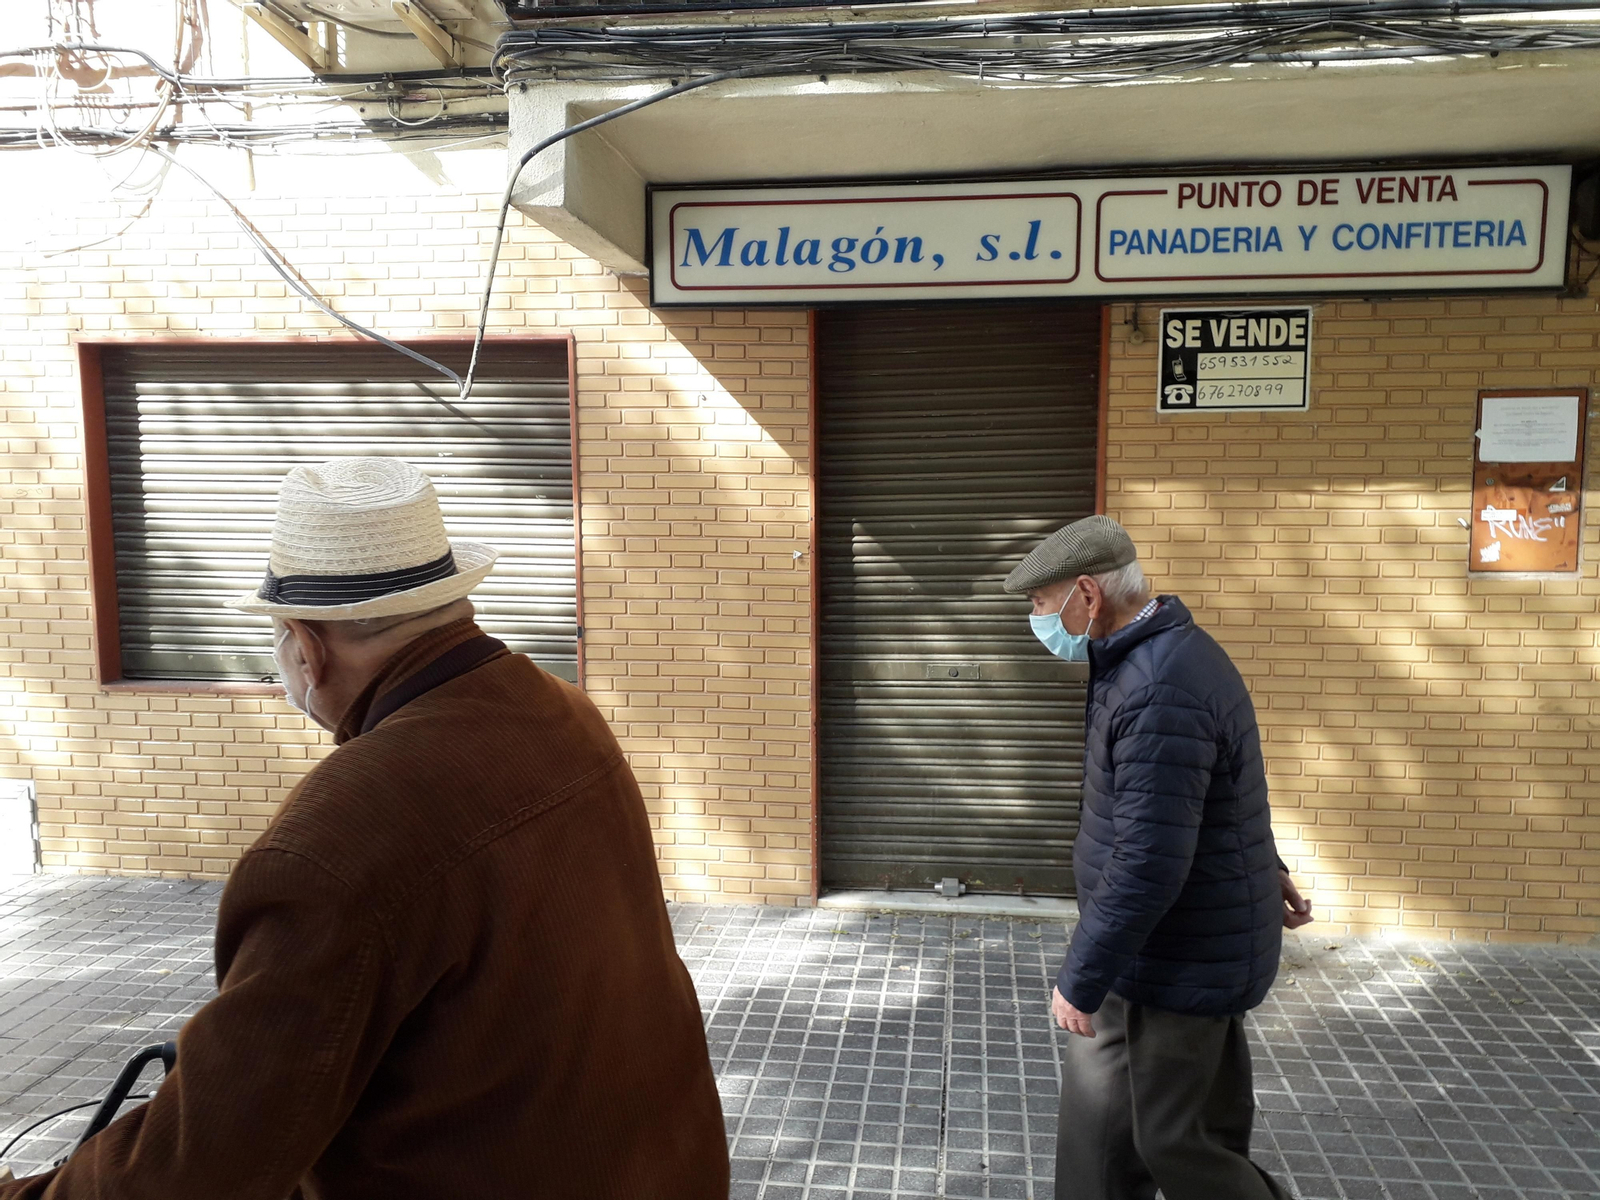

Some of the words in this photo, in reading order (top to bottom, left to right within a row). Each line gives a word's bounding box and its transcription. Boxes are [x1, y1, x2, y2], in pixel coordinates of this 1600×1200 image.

[1177, 179, 1282, 209] PUNTO
[1297, 178, 1340, 206] DE
[1356, 175, 1458, 204] VENTA
[679, 226, 945, 273] Malagón,
[975, 220, 1063, 262] s.l.
[1109, 225, 1283, 256] PANADERIA
[1298, 224, 1318, 251] Y
[1332, 219, 1527, 252] CONFITERIA
[1166, 319, 1202, 348] SE
[1209, 317, 1306, 347] VENDE
